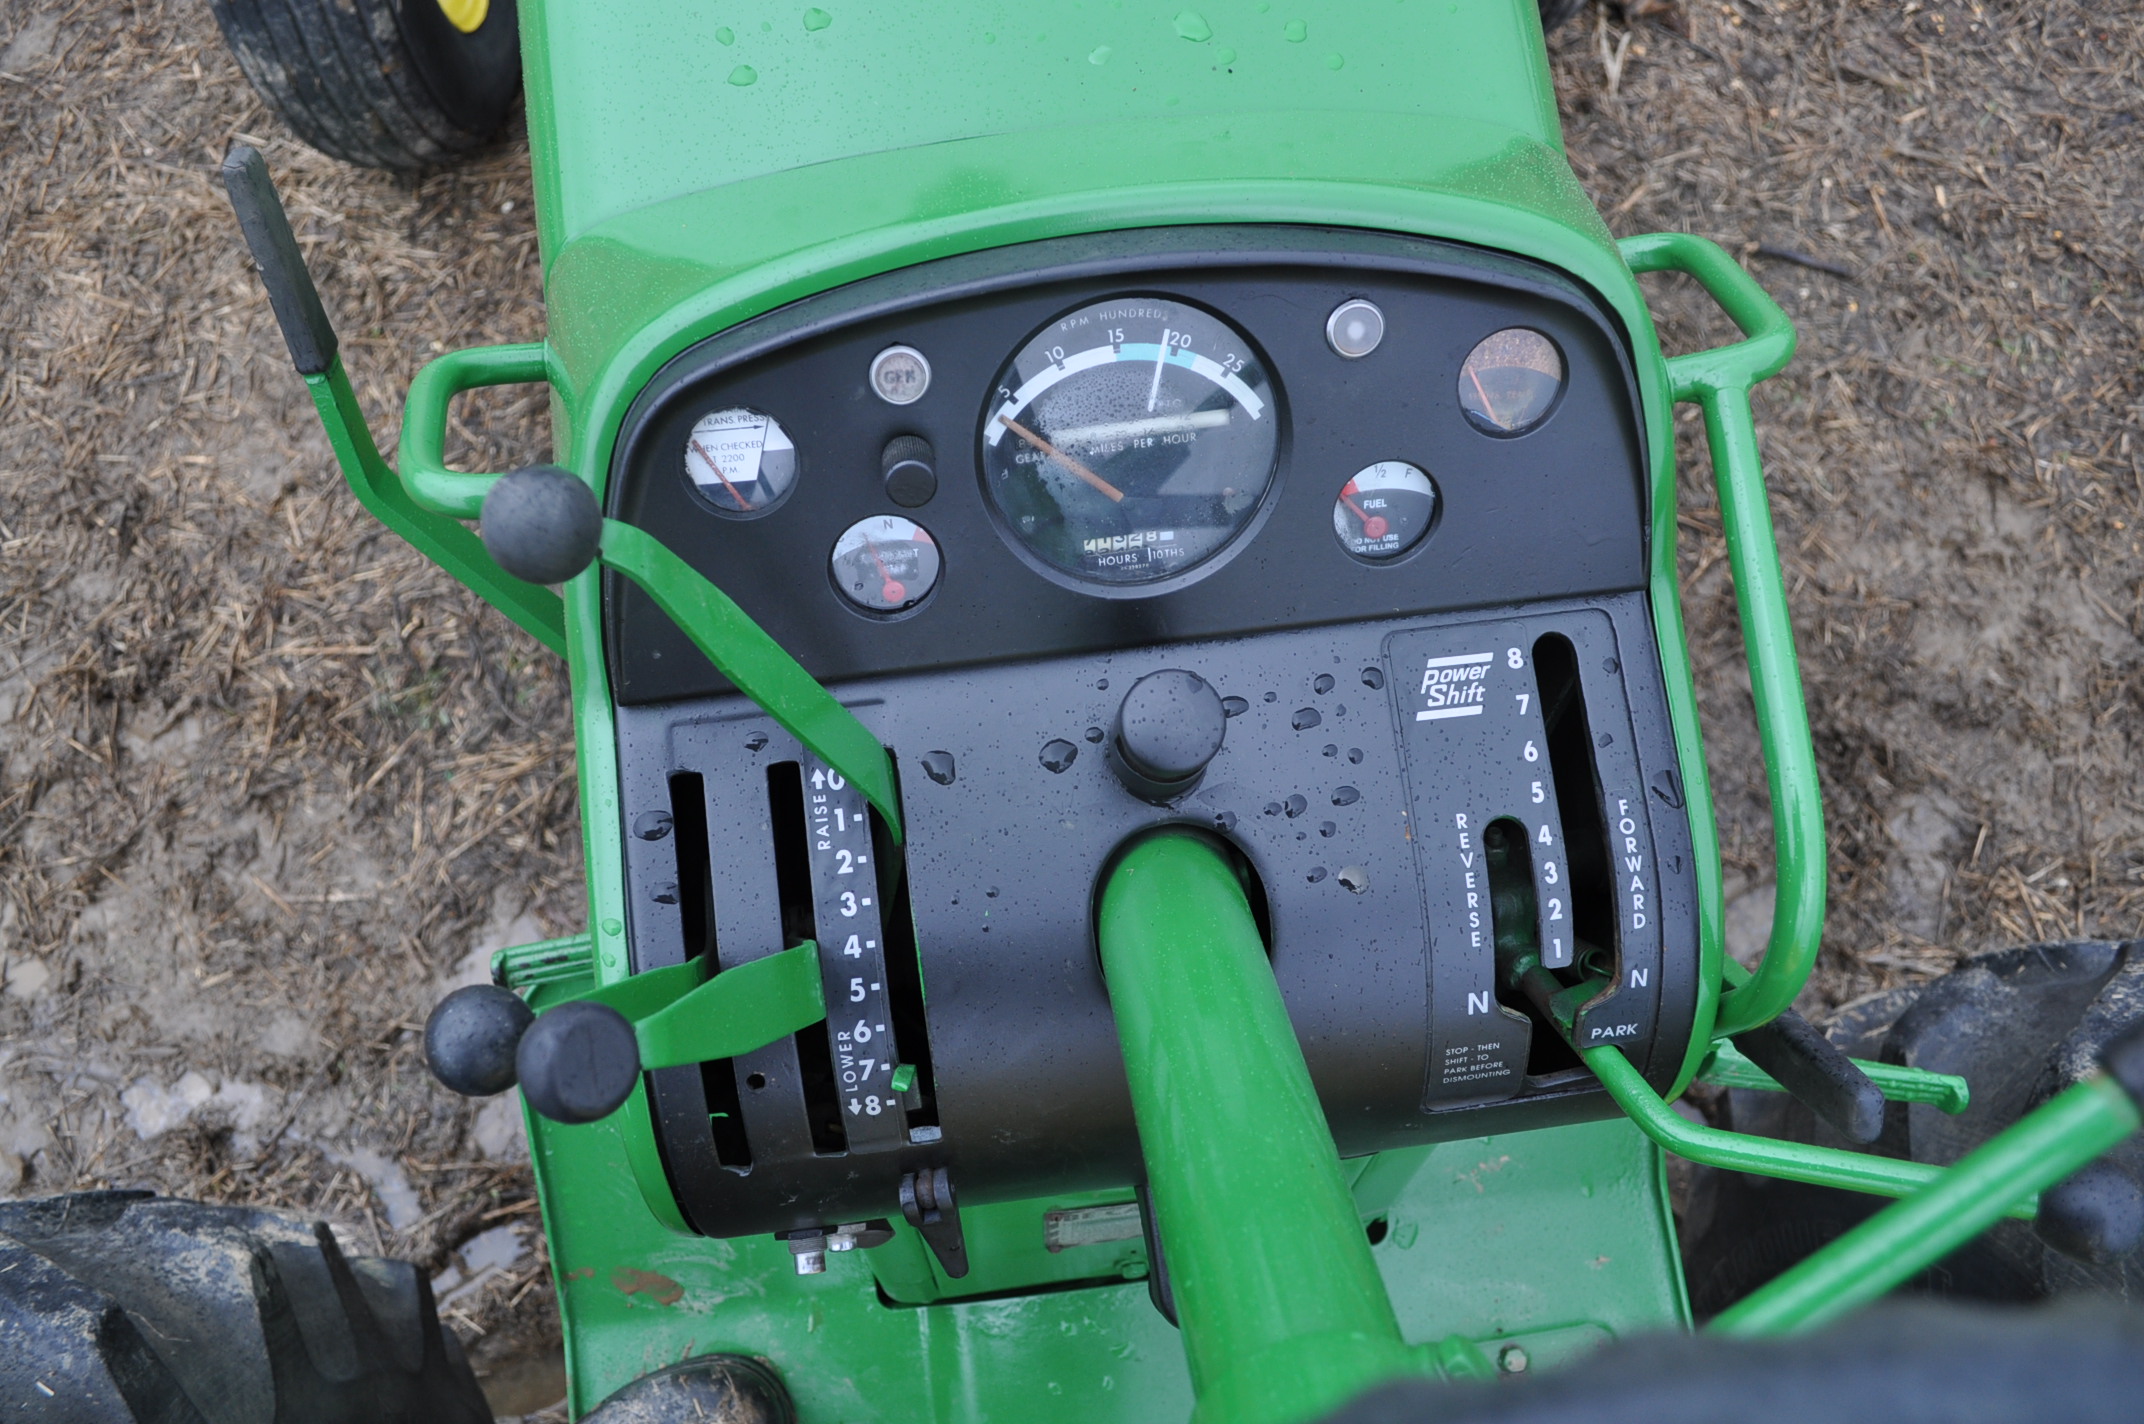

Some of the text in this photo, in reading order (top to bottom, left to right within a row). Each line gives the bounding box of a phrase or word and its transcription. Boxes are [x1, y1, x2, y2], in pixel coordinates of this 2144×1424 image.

[1060, 308, 1169, 332] RPM HUNDREDS
[1107, 328, 1125, 343] 15
[1169, 331, 1192, 348] 20
[1044, 346, 1065, 363] 10
[1222, 353, 1246, 373] 25
[998, 384, 1011, 398] 5
[720, 440, 764, 451] CHECKED
[1091, 432, 1197, 454] MILES PER HOUR
[721, 453, 745, 463] 2200
[1405, 467, 1414, 479] F
[1363, 498, 1388, 510] FUEL
[883, 518, 894, 530] N
[1368, 541, 1400, 551] FILLING
[1382, 533, 1400, 542] USE
[1098, 553, 1138, 567] HOURS
[1507, 647, 1524, 669] 8
[1420, 664, 1491, 695] Power
[1427, 681, 1486, 707] Shift
[1515, 694, 1530, 715] 7
[1523, 741, 1539, 762] 6
[826, 767, 845, 791] 0
[1531, 782, 1545, 803] 5
[813, 794, 832, 850] RAISE
[833, 807, 846, 832] 1
[1538, 824, 1553, 845] 4
[835, 849, 854, 874] 2
[1618, 798, 1646, 930] FORWARD
[1455, 813, 1481, 948] REVERSE
[1544, 862, 1559, 884] 3
[840, 891, 858, 917] 3
[1548, 898, 1563, 920] 2
[843, 934, 861, 959] 4
[1553, 938, 1563, 959] 1
[1630, 969, 1648, 988] N
[850, 977, 866, 1003] 5
[1467, 990, 1489, 1015] N
[853, 1020, 872, 1044] 6
[1591, 1023, 1638, 1039] PARK
[1445, 1047, 1469, 1056] STOP
[1477, 1042, 1500, 1051] THEN
[1445, 1056, 1468, 1066] SHIFT
[1476, 1053, 1490, 1062] TO
[838, 1031, 858, 1091] LOWER
[858, 1058, 875, 1081] 7
[1444, 1061, 1504, 1074] PARK BEFORE
[1443, 1068, 1511, 1084] DISMOUNTING
[864, 1095, 882, 1116] 8
